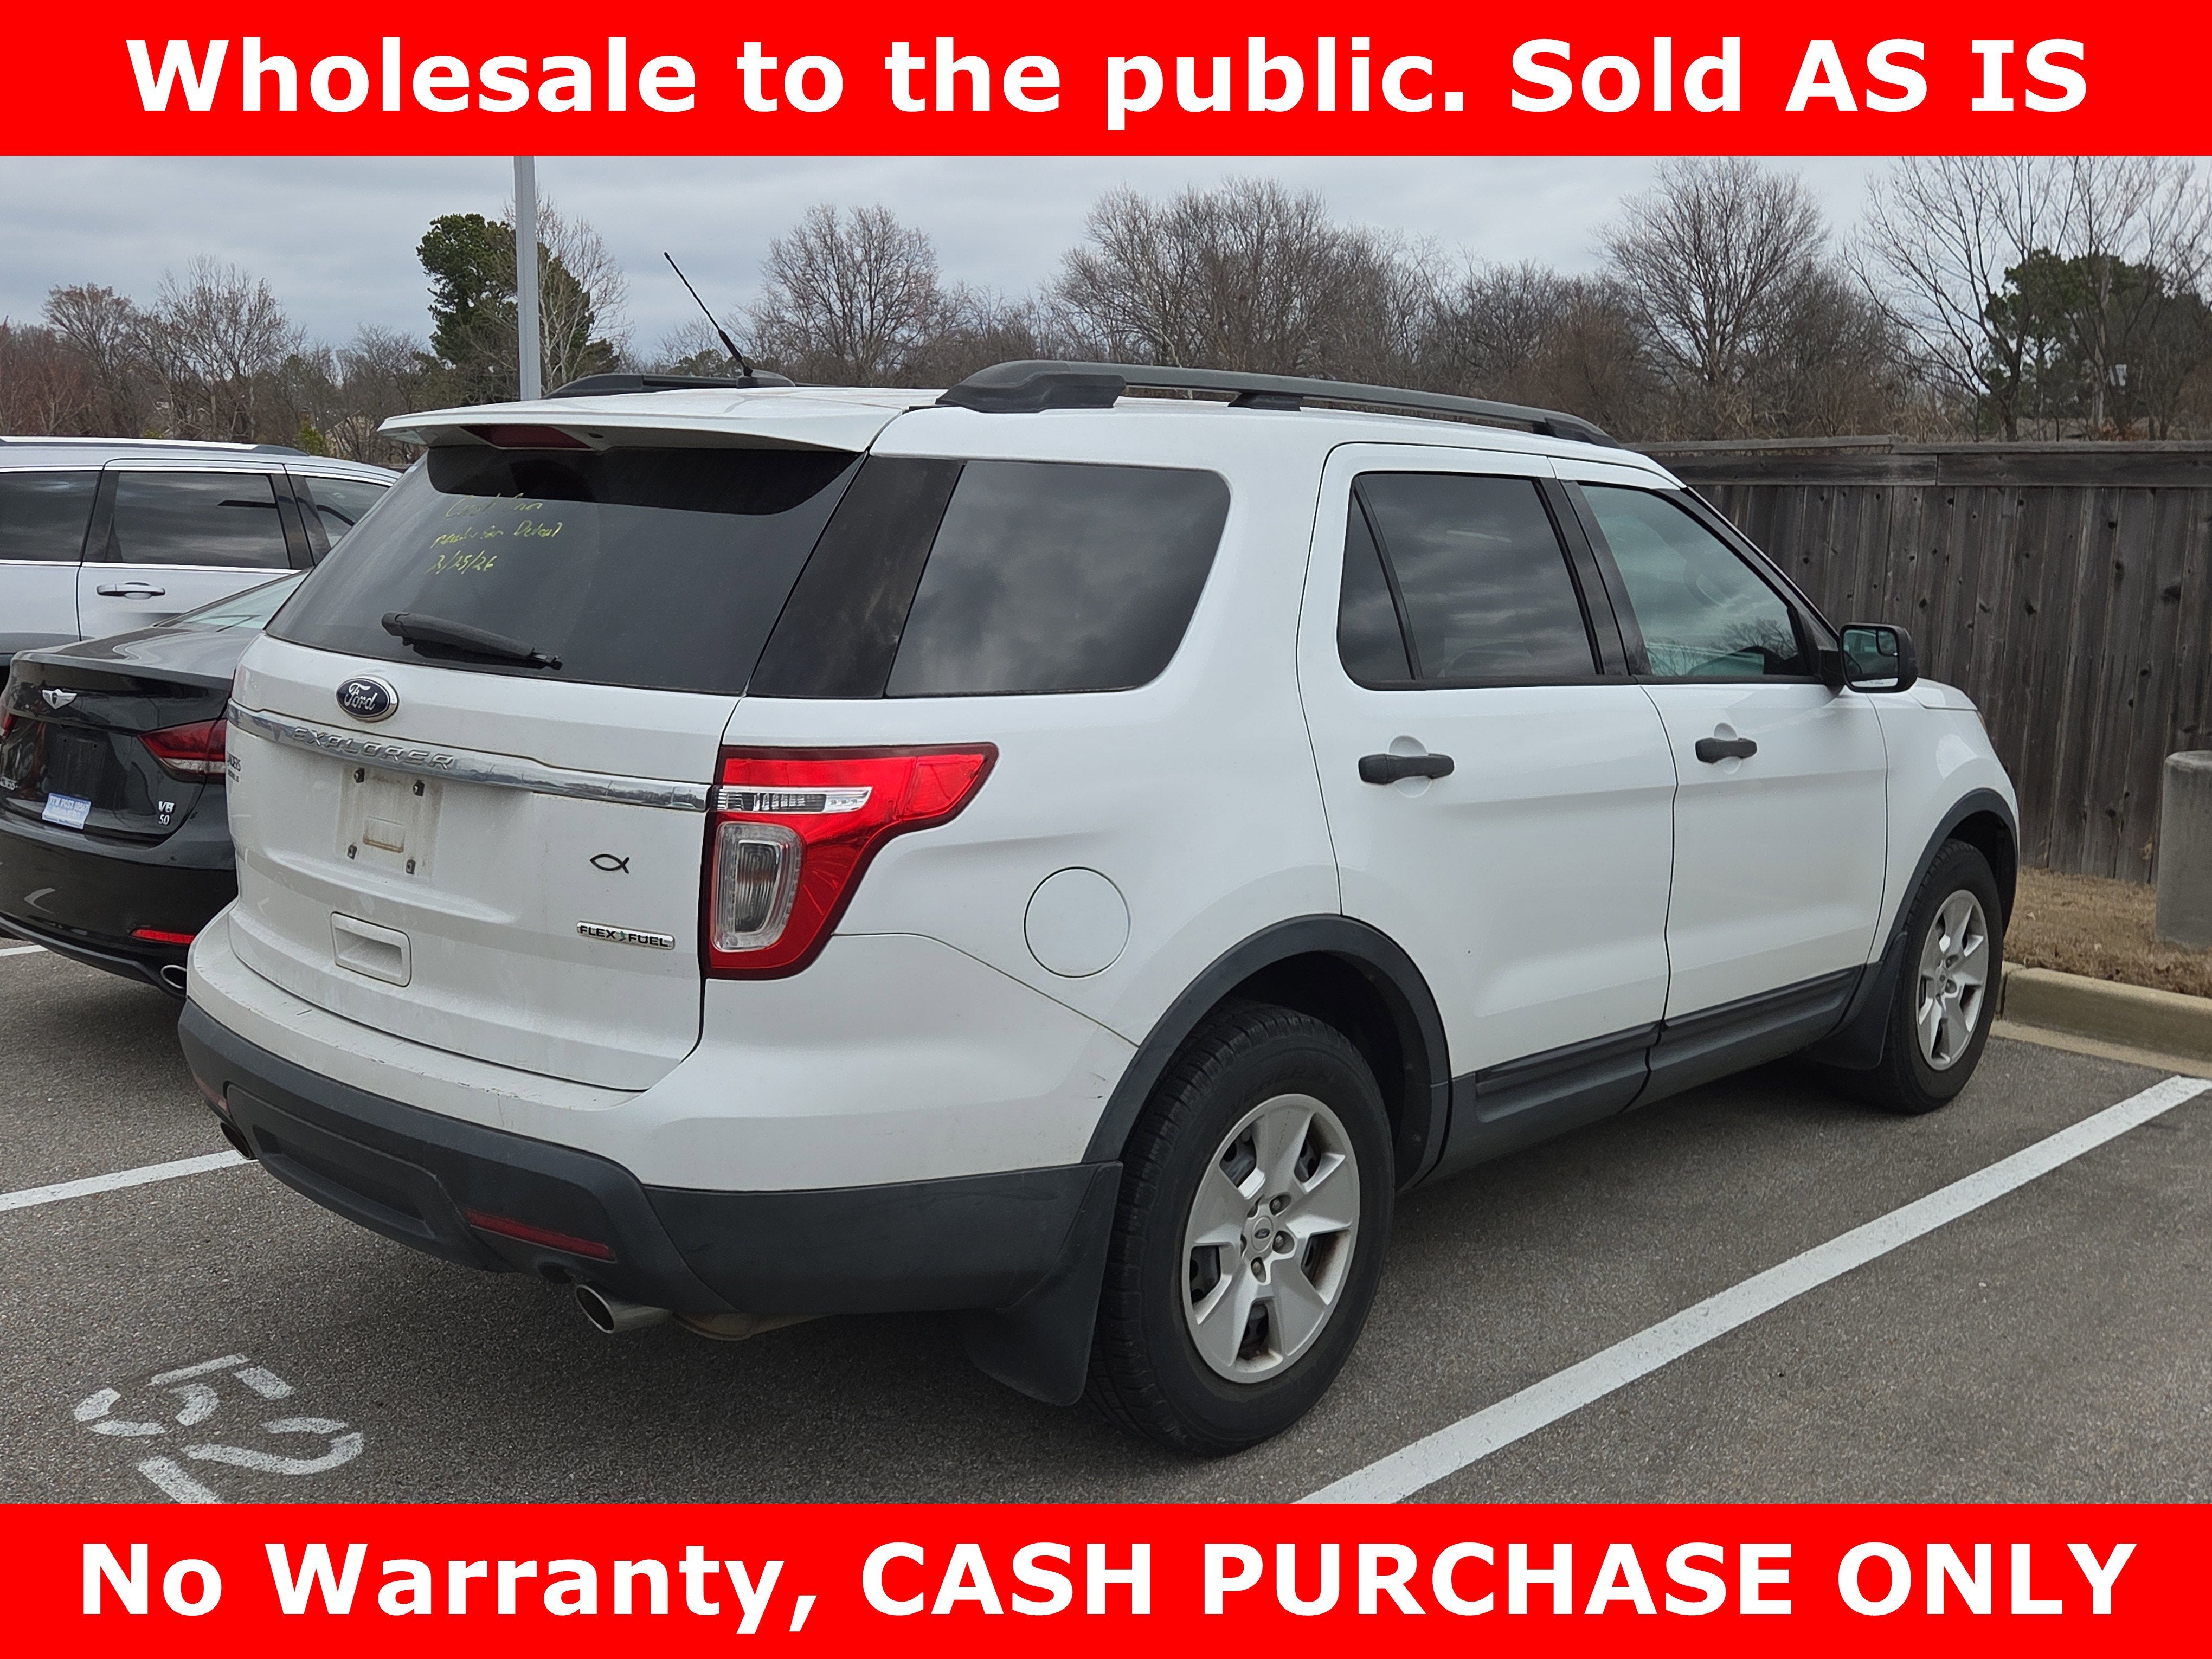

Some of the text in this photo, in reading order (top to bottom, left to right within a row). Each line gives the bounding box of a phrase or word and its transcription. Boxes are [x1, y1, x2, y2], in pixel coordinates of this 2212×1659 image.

[344, 682, 378, 711] Ford
[292, 726, 454, 770] EXPLORER
[158, 801, 175, 813] V8
[580, 925, 669, 948] FLEX FUEL
